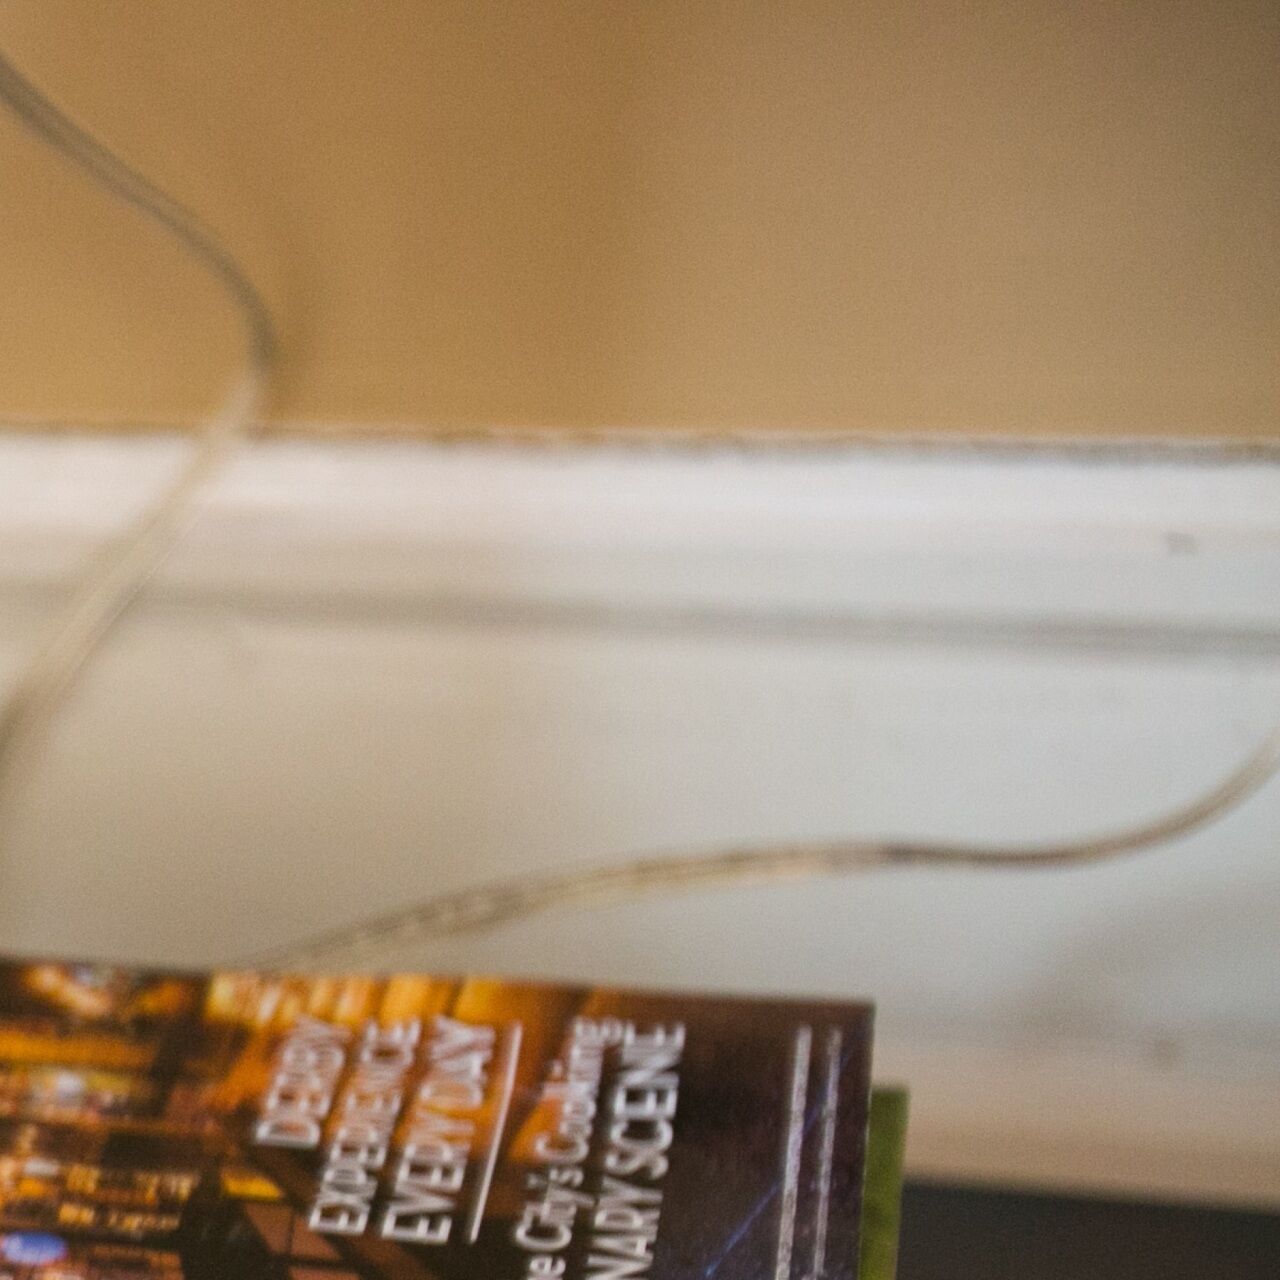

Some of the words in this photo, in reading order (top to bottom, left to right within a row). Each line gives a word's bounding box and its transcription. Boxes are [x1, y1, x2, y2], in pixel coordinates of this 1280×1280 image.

[420, 1014, 496, 1110] DAY
[604, 1022, 686, 1181] SCENE
[381, 1111, 476, 1244] EVERY
